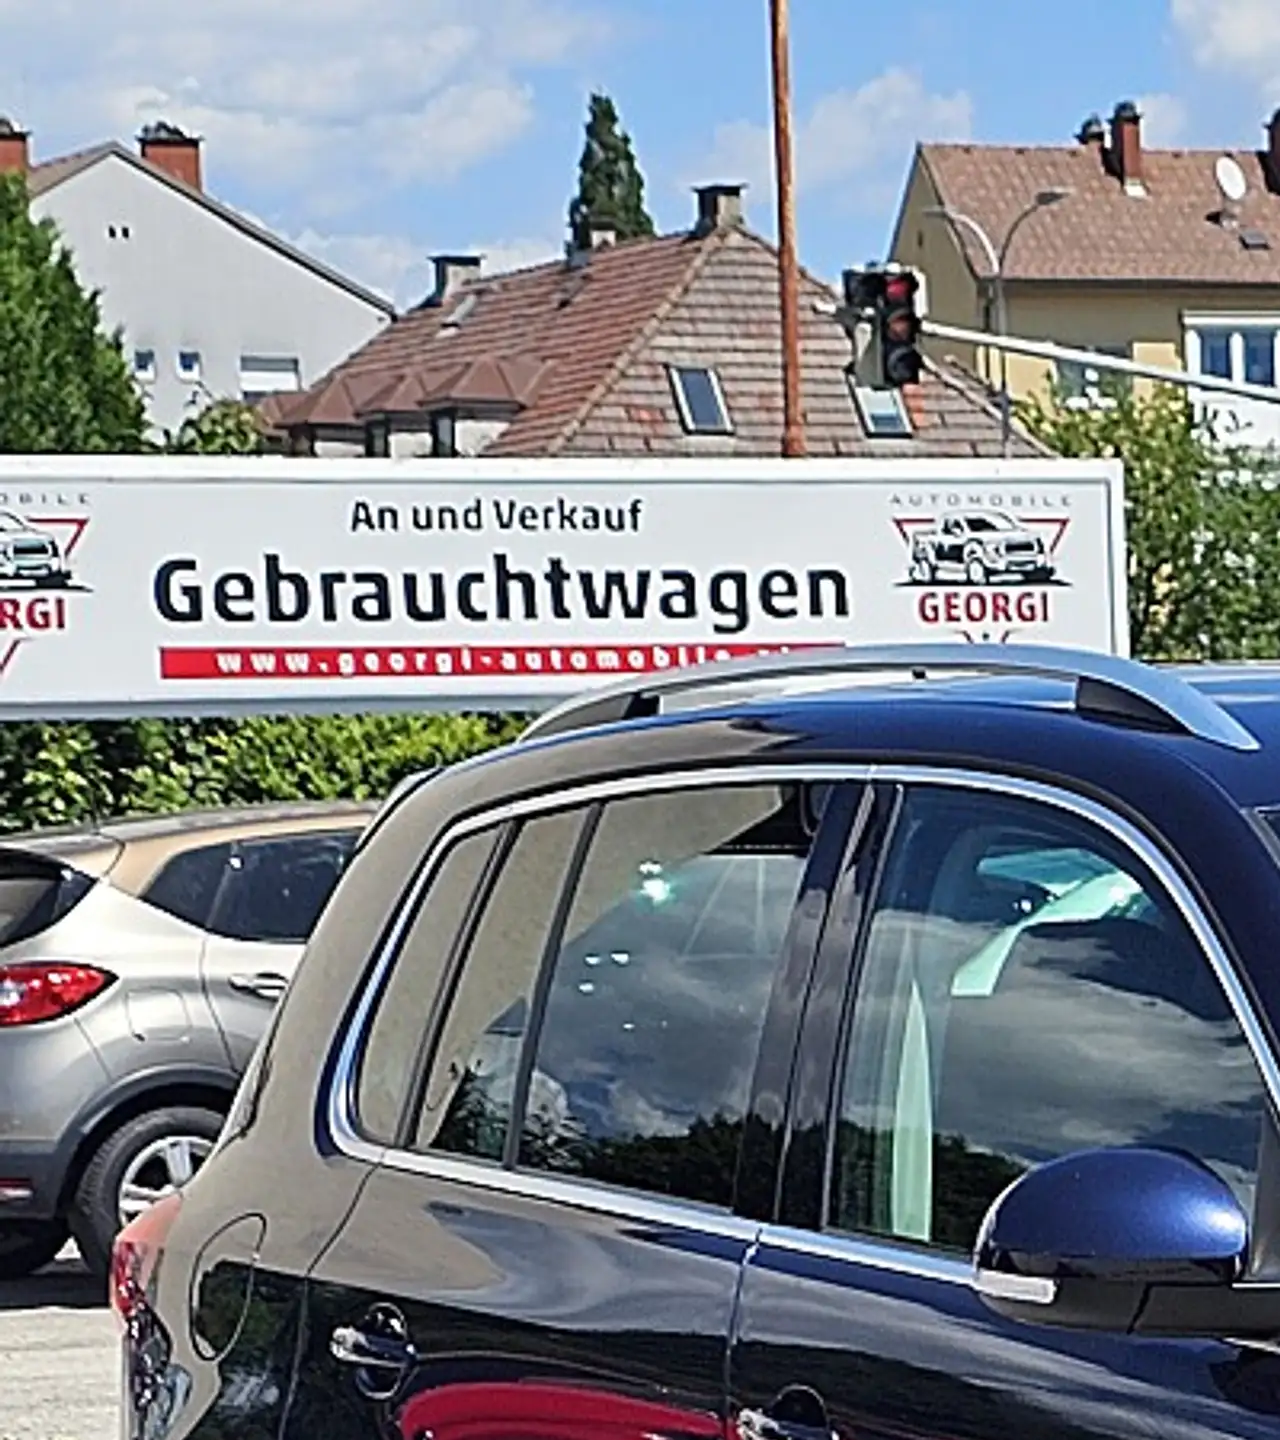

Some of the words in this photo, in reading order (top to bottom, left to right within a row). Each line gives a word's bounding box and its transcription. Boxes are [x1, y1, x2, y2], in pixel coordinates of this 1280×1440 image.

[351, 501, 398, 532] An
[412, 498, 483, 531] und
[493, 498, 643, 532] Verkauf
[890, 494, 1073, 506] AUTOMOBILE
[153, 552, 850, 635] Gebrauchtwagen
[918, 591, 1050, 623] GEORGI
